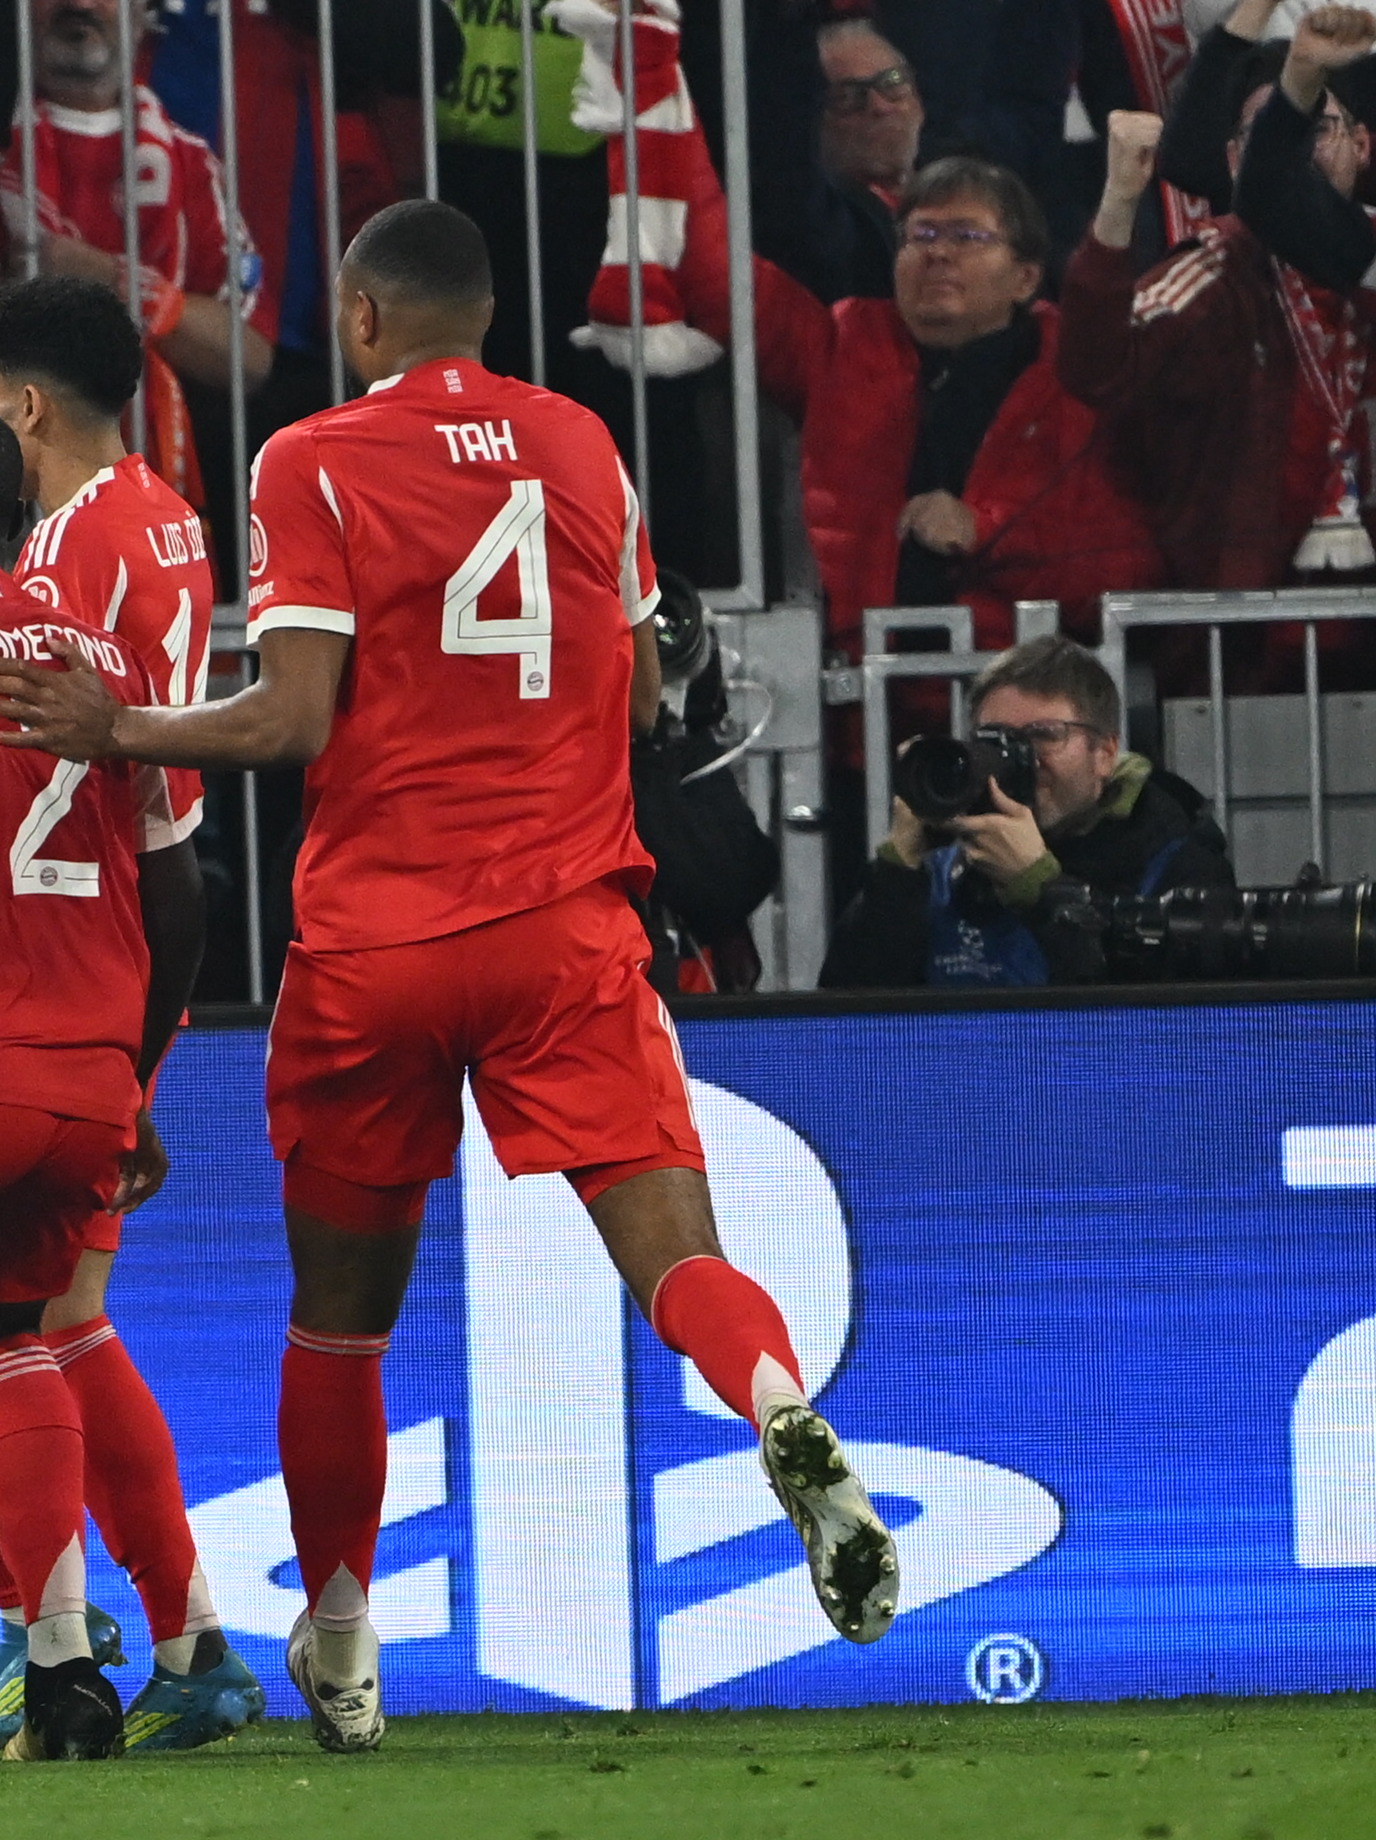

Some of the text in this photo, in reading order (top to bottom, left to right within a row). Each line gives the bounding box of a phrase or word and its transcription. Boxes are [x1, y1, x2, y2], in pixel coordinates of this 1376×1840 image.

[435, 419, 518, 463] TAH
[441, 479, 552, 699] 4
[9, 730, 100, 898] 2
